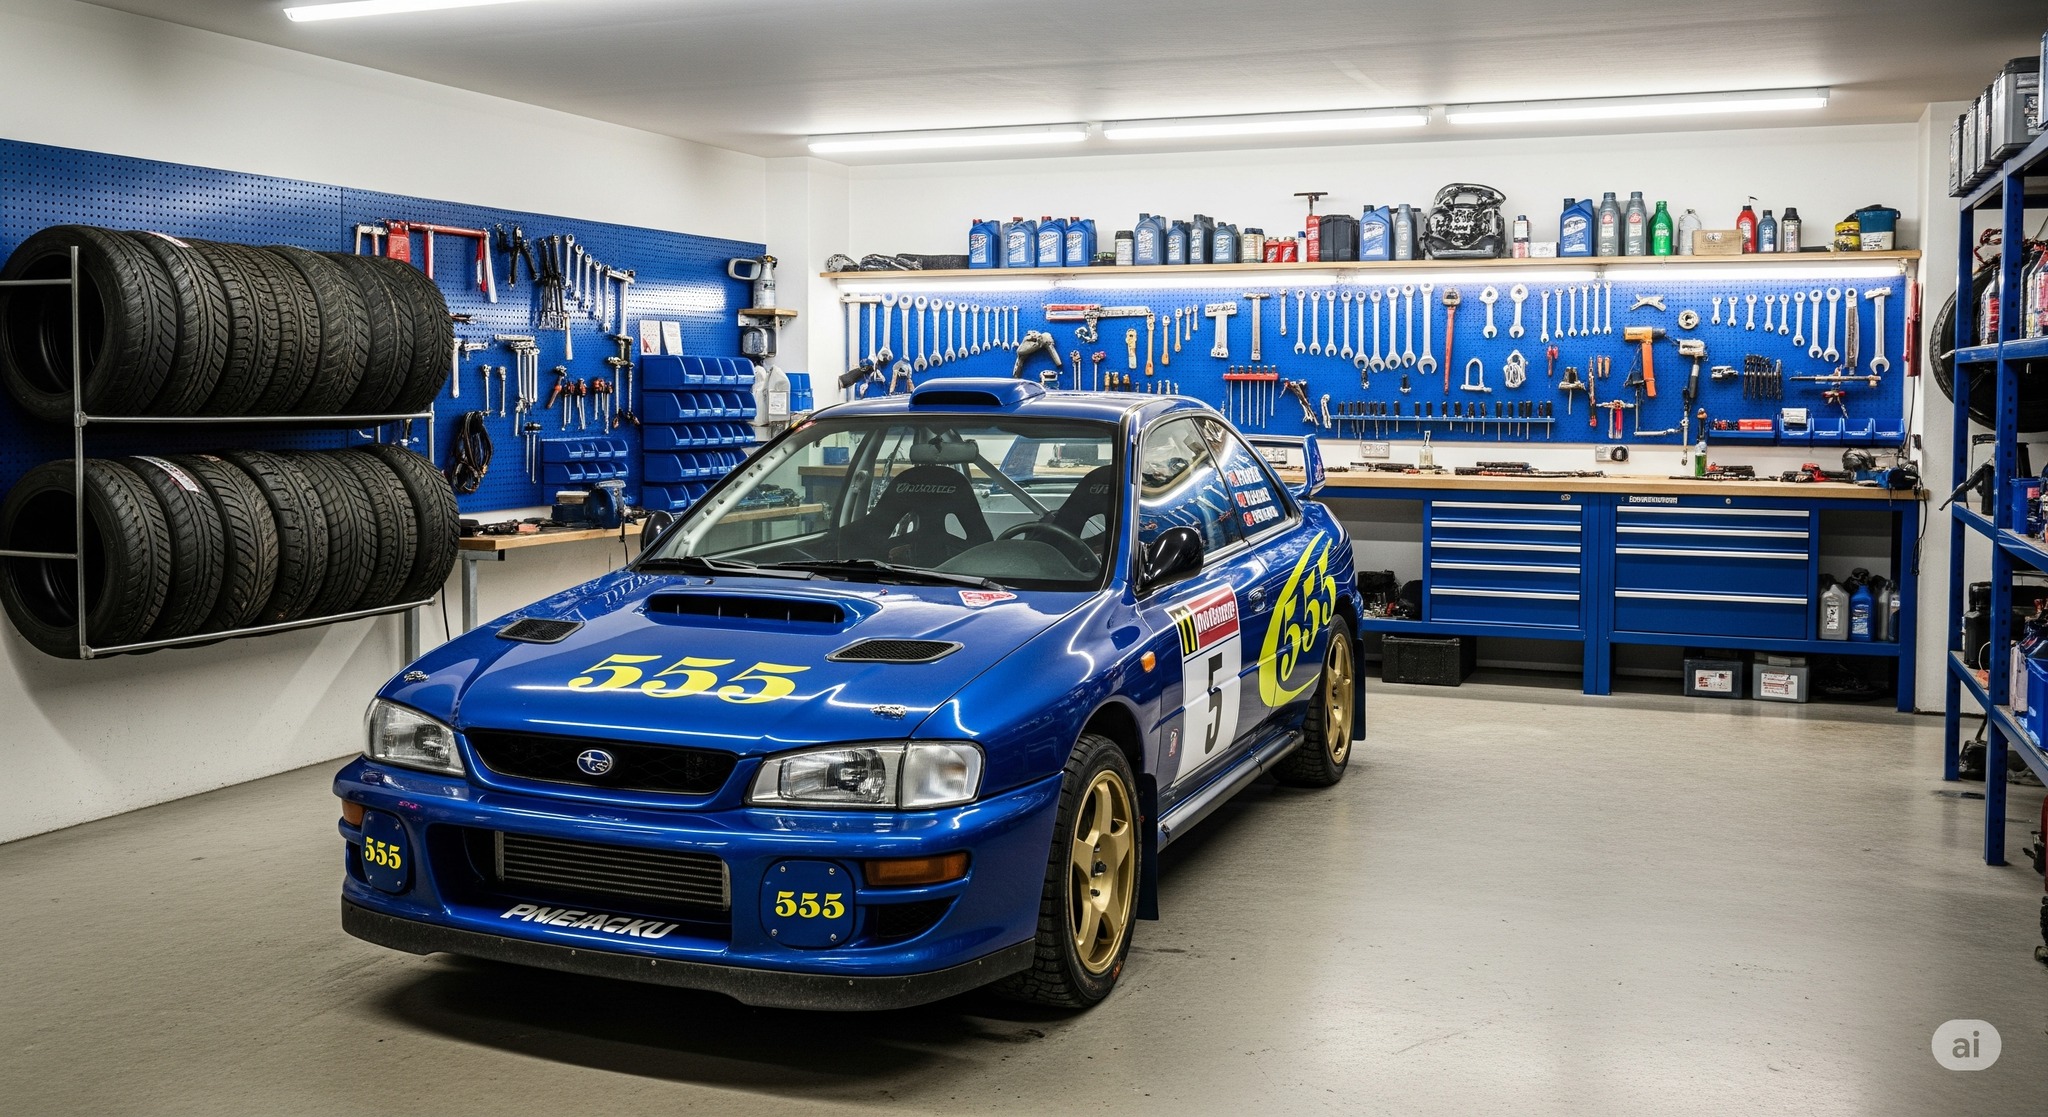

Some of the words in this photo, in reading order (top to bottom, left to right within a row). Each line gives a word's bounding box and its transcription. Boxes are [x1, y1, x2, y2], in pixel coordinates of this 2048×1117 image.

[1280, 537, 1337, 682] 555
[568, 653, 811, 704] 555
[1204, 652, 1223, 755] 5
[364, 836, 402, 869] 555
[775, 891, 845, 919] 555
